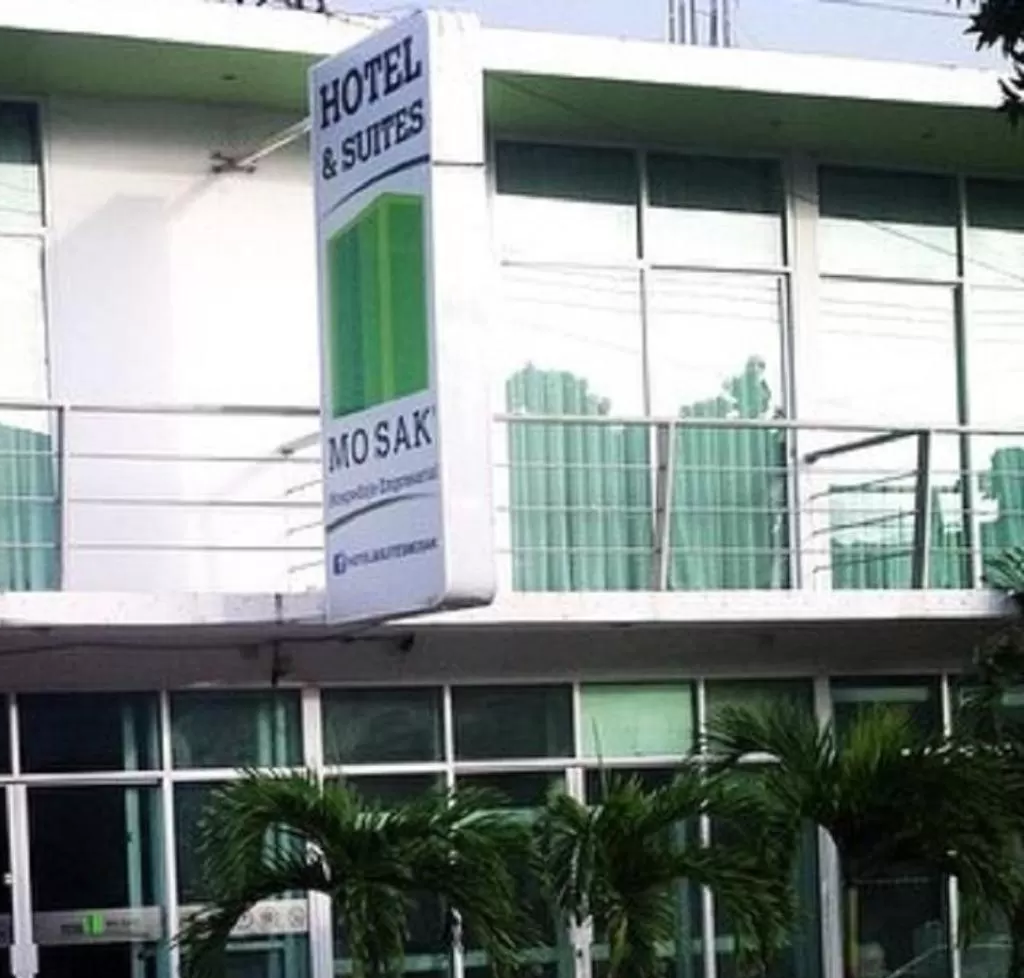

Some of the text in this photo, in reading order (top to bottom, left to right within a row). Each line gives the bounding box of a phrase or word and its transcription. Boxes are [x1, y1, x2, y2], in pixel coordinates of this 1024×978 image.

[319, 35, 422, 129] HOTEL
[322, 98, 424, 180] & SUITES
[328, 409, 433, 473] MOSAK
